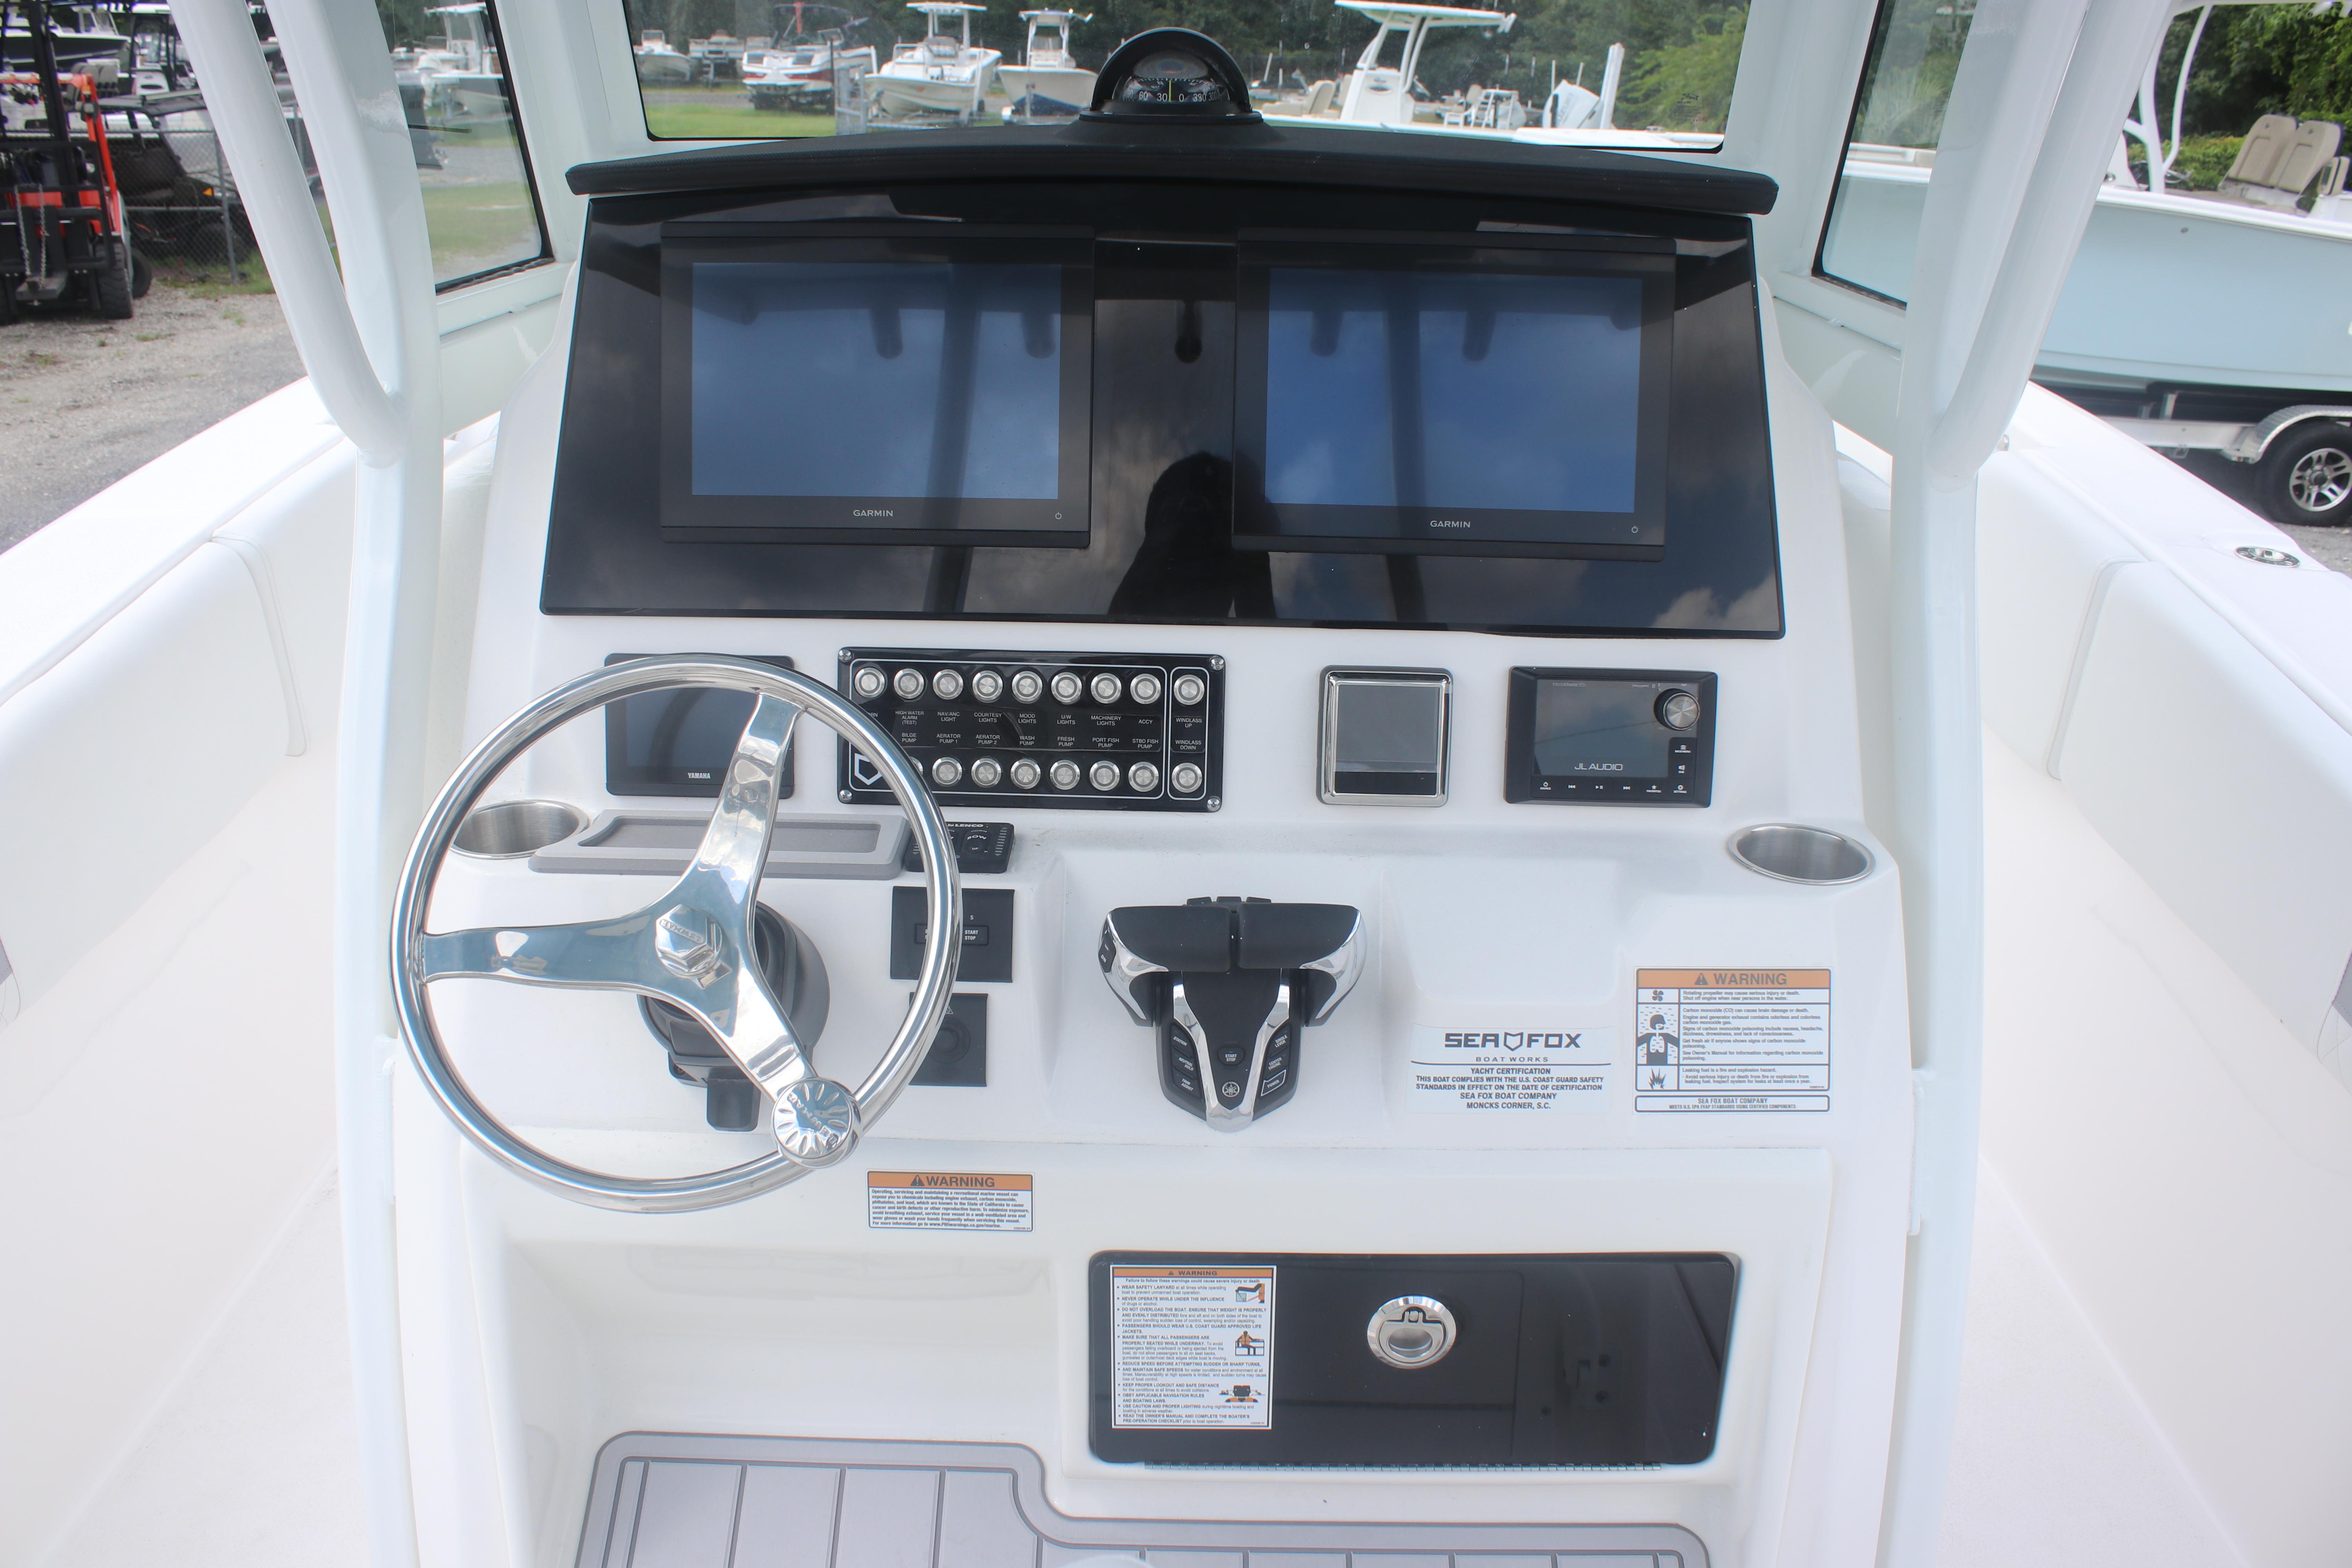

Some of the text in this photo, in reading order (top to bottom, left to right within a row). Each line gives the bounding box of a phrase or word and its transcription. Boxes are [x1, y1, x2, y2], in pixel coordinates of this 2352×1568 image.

[1139, 91, 1148, 100] 60
[1179, 94, 1184, 102] 0
[1713, 973, 1787, 985] WARNING
[1173, 1036, 1187, 1046] STATION
[1275, 1034, 1288, 1043] SINGLE
[1445, 1033, 1581, 1048] SEA FOX
[1275, 1040, 1286, 1048] LEVER
[1178, 1057, 1193, 1067] NEUTRAL
[1268, 1062, 1281, 1071] ENGINE
[1269, 1057, 1282, 1066] CENTER
[1181, 1083, 1194, 1091] ASSIST
[1267, 1079, 1280, 1089] POWER
[926, 1176, 995, 1187] WARNING
